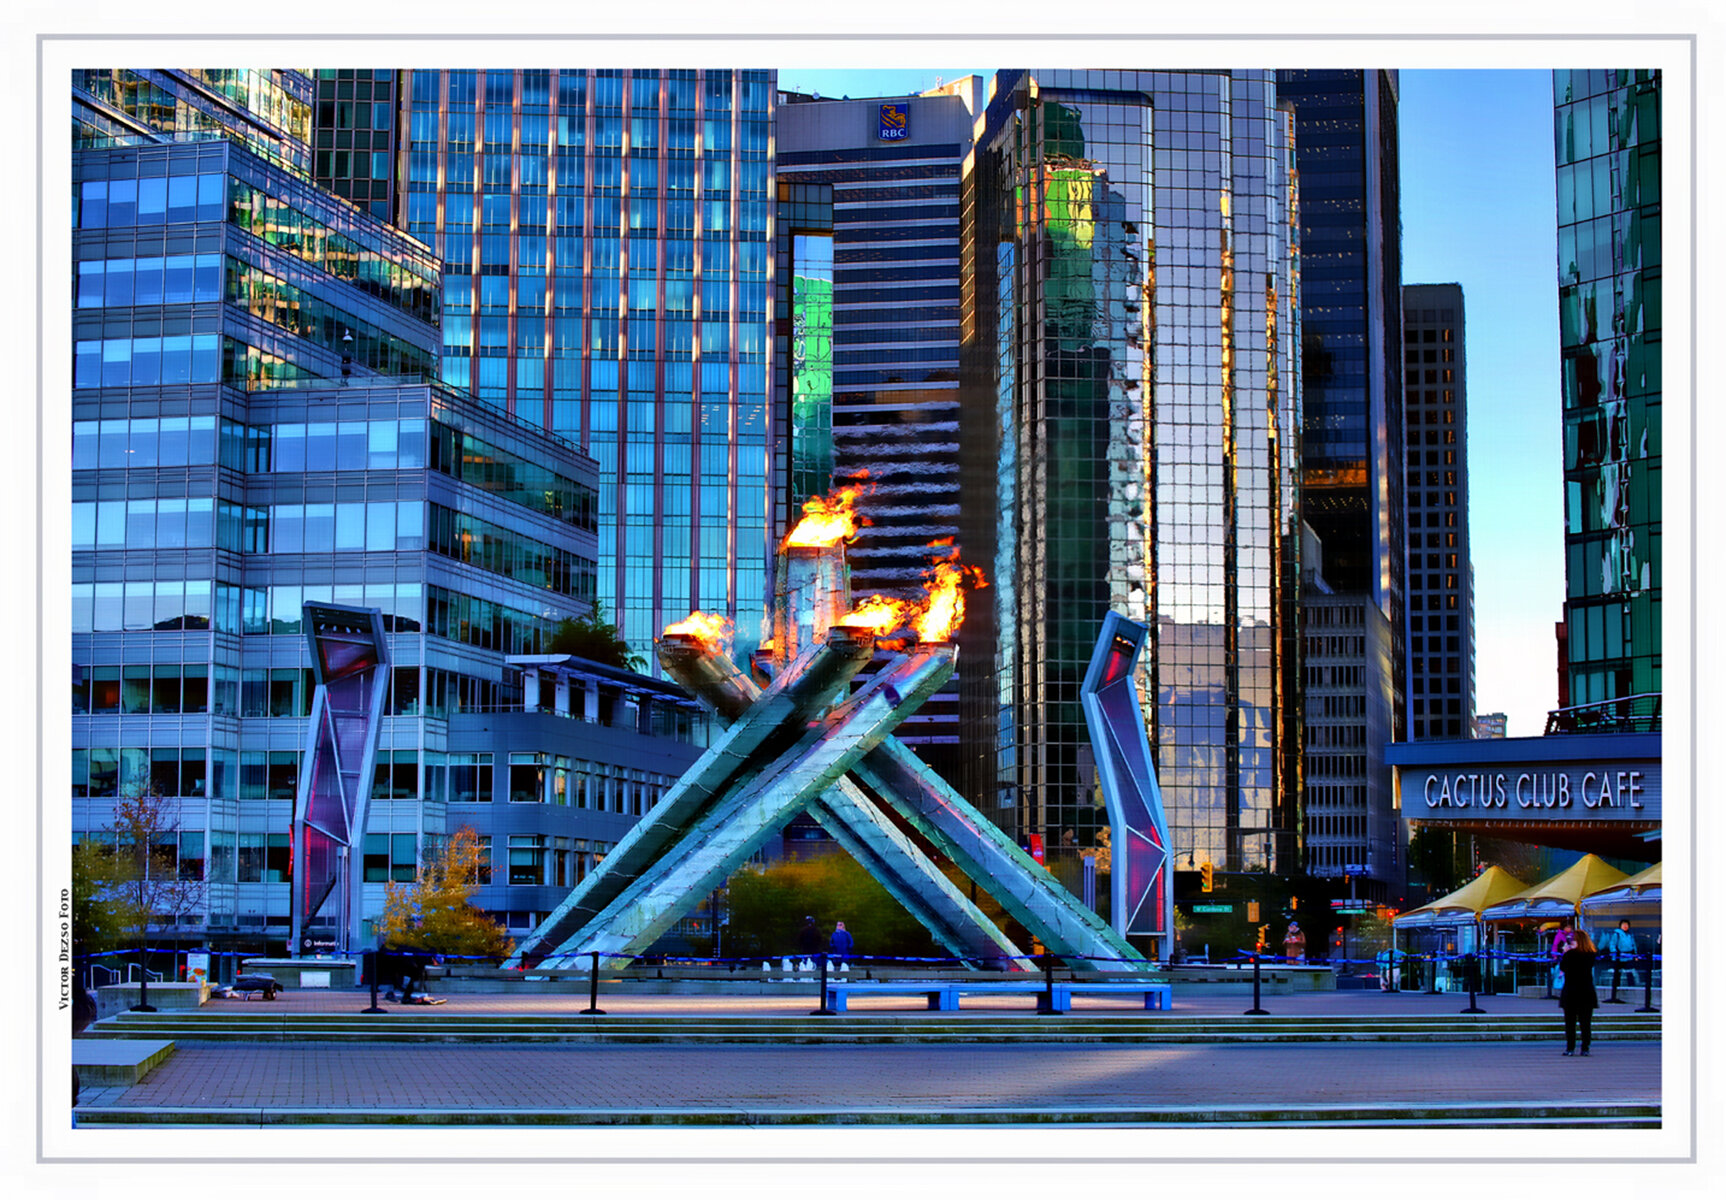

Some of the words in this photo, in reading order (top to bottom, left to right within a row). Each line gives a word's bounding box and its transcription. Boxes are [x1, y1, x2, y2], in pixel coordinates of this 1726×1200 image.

[882, 128, 905, 138] RBC
[1424, 774, 1506, 807] CACTUS
[1516, 773, 1570, 807] CLUB
[1581, 772, 1641, 807] CAFE
